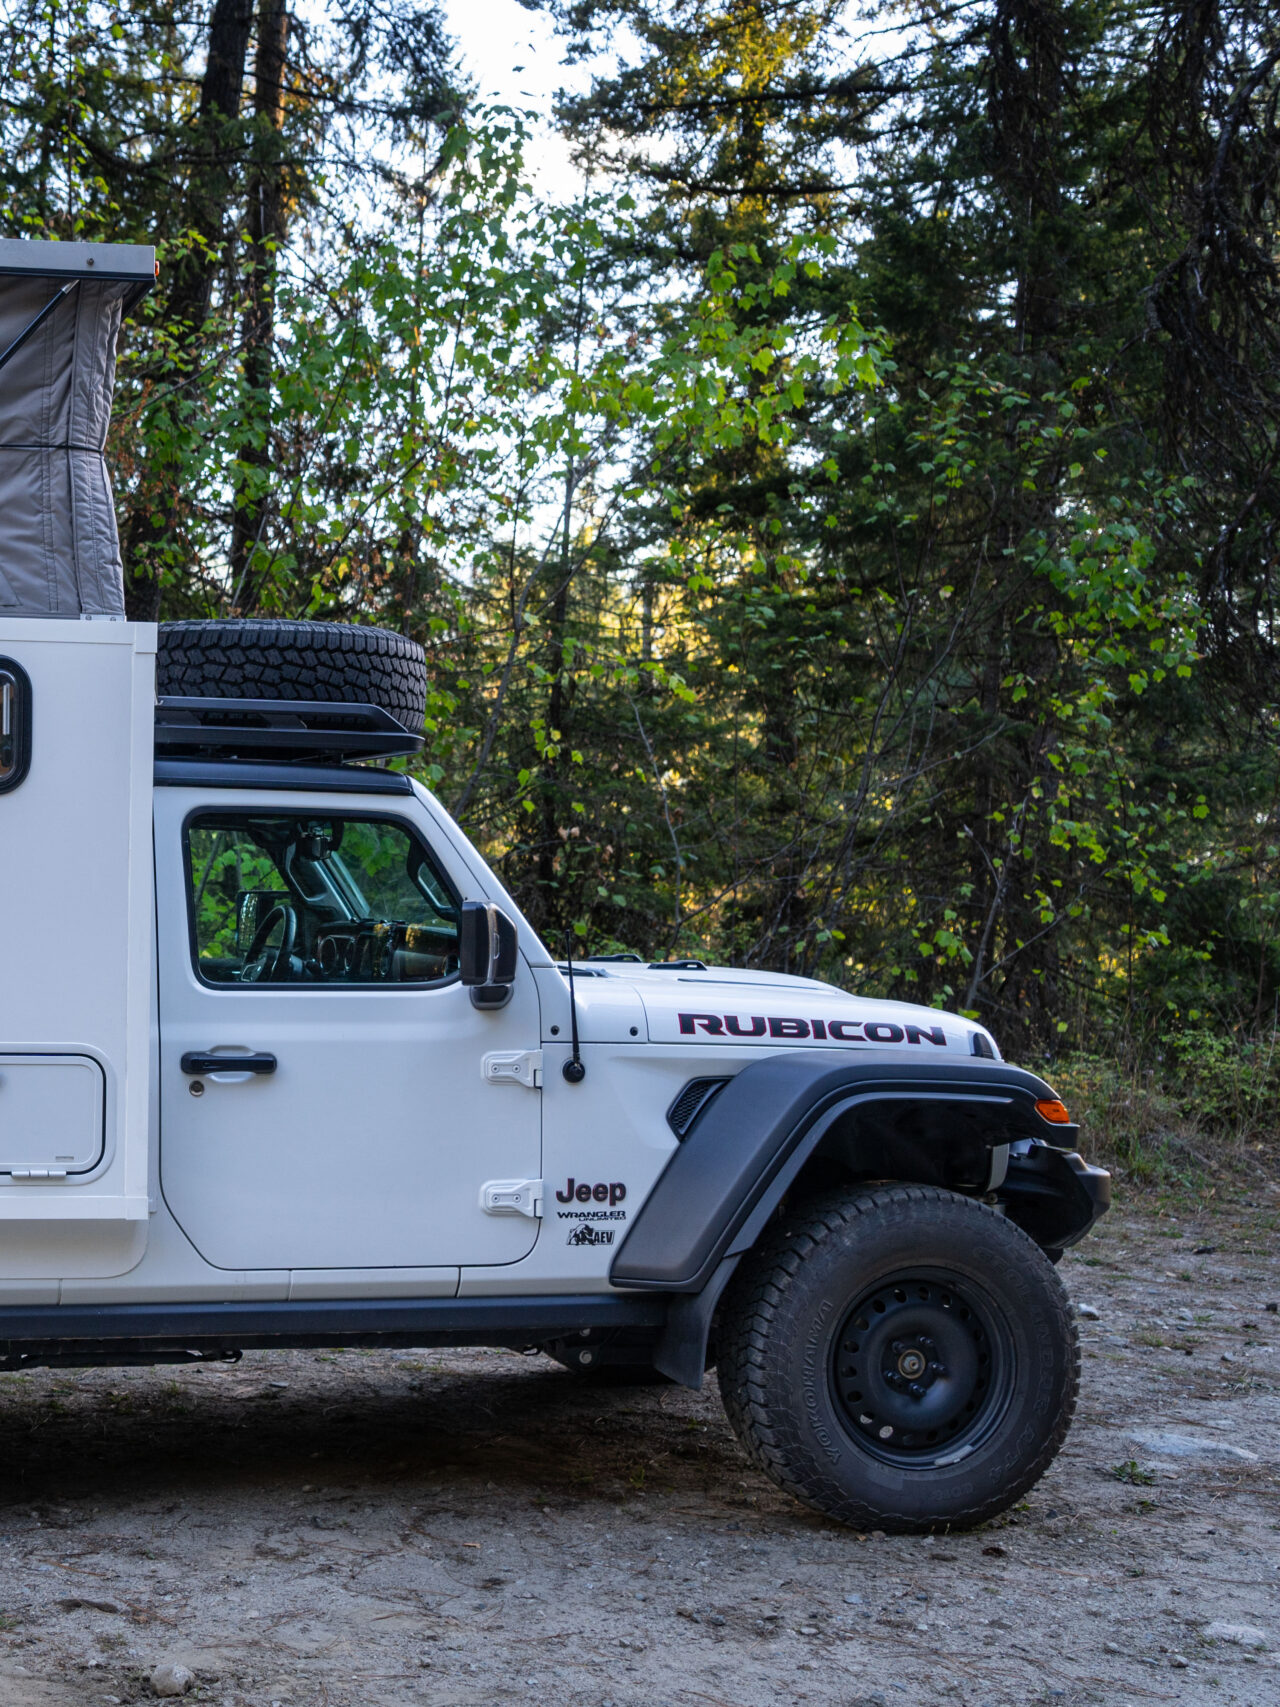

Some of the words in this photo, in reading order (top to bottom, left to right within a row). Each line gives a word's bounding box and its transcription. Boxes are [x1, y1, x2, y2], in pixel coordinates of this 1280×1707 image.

[678, 1013, 947, 1046] RUBICON
[556, 1178, 626, 1206] Jeep
[557, 1210, 626, 1219] WRANGLER
[593, 1231, 613, 1244] AEV
[801, 1298, 843, 1465] YOKOHAMA
